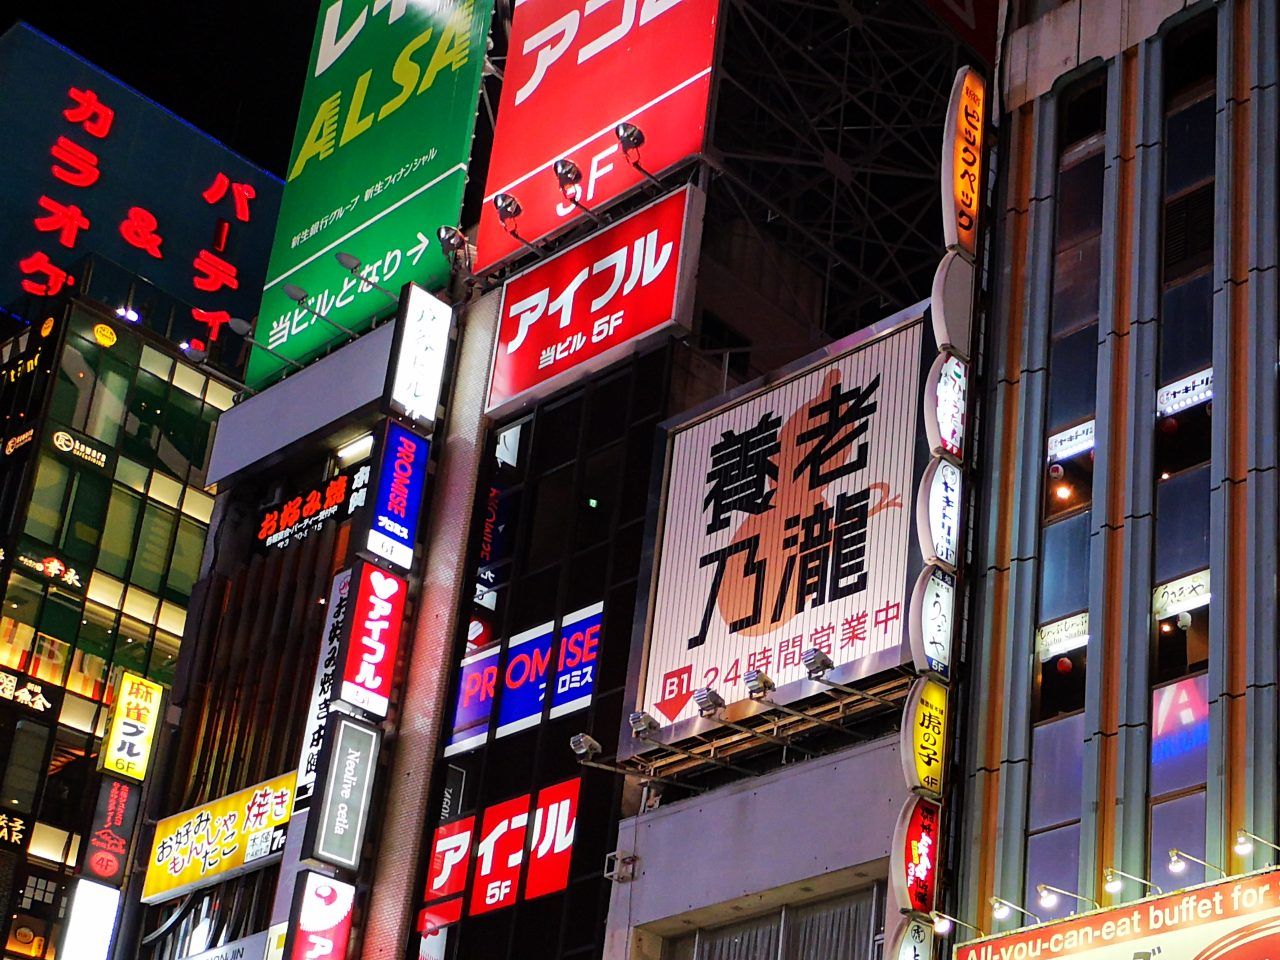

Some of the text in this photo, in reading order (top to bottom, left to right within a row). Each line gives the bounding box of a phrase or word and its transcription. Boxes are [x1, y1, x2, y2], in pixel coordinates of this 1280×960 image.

[288, 3, 474, 182] ALSA
[266, 247, 403, 351] 当ビルとなり
[507, 228, 674, 355] アイフル
[538, 309, 624, 370] 当ビル 5F
[387, 436, 417, 519] PROMISE
[702, 372, 881, 536] 養老
[377, 514, 410, 540] プロミス
[687, 487, 871, 651] 乃瀧
[354, 596, 393, 690] アイフル
[462, 623, 601, 709] PROMISE
[665, 673, 691, 700] B1
[702, 600, 901, 688] 24時間営業中
[115, 758, 137, 773] 6F
[917, 711, 942, 767] 虎の子
[334, 747, 362, 836] Neolive cetla
[432, 798, 577, 891] アイフル
[485, 879, 512, 905] 5F
[1149, 887, 1223, 926] buffet
[1232, 883, 1271, 910] for
